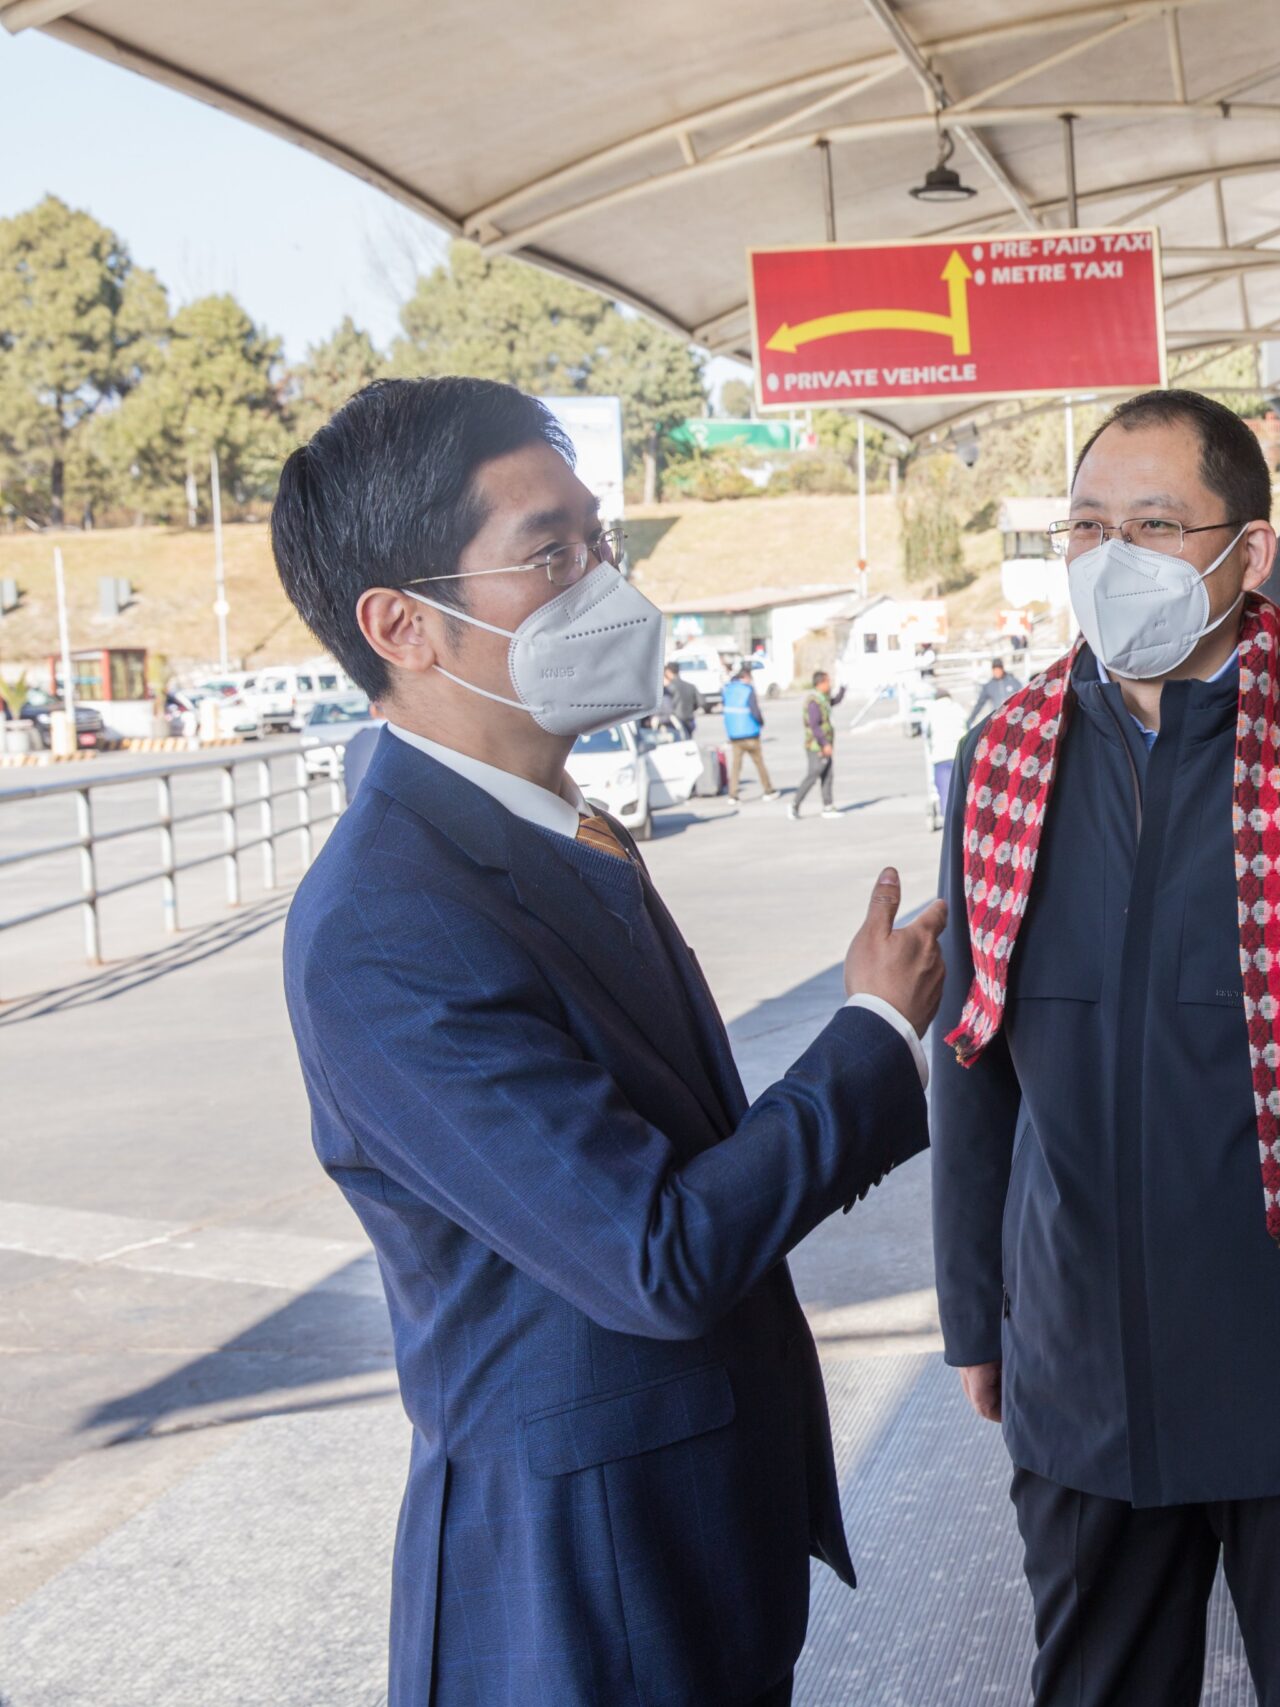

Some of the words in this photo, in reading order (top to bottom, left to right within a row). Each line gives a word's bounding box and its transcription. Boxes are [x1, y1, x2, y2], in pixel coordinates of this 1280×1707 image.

[1100, 233, 1152, 253] TAXI
[991, 264, 1067, 285] METRE
[1071, 260, 1123, 280] TAXI
[784, 368, 878, 391] PRIVATE
[882, 363, 977, 386] VEHICLE
[541, 667, 575, 678] KN95
